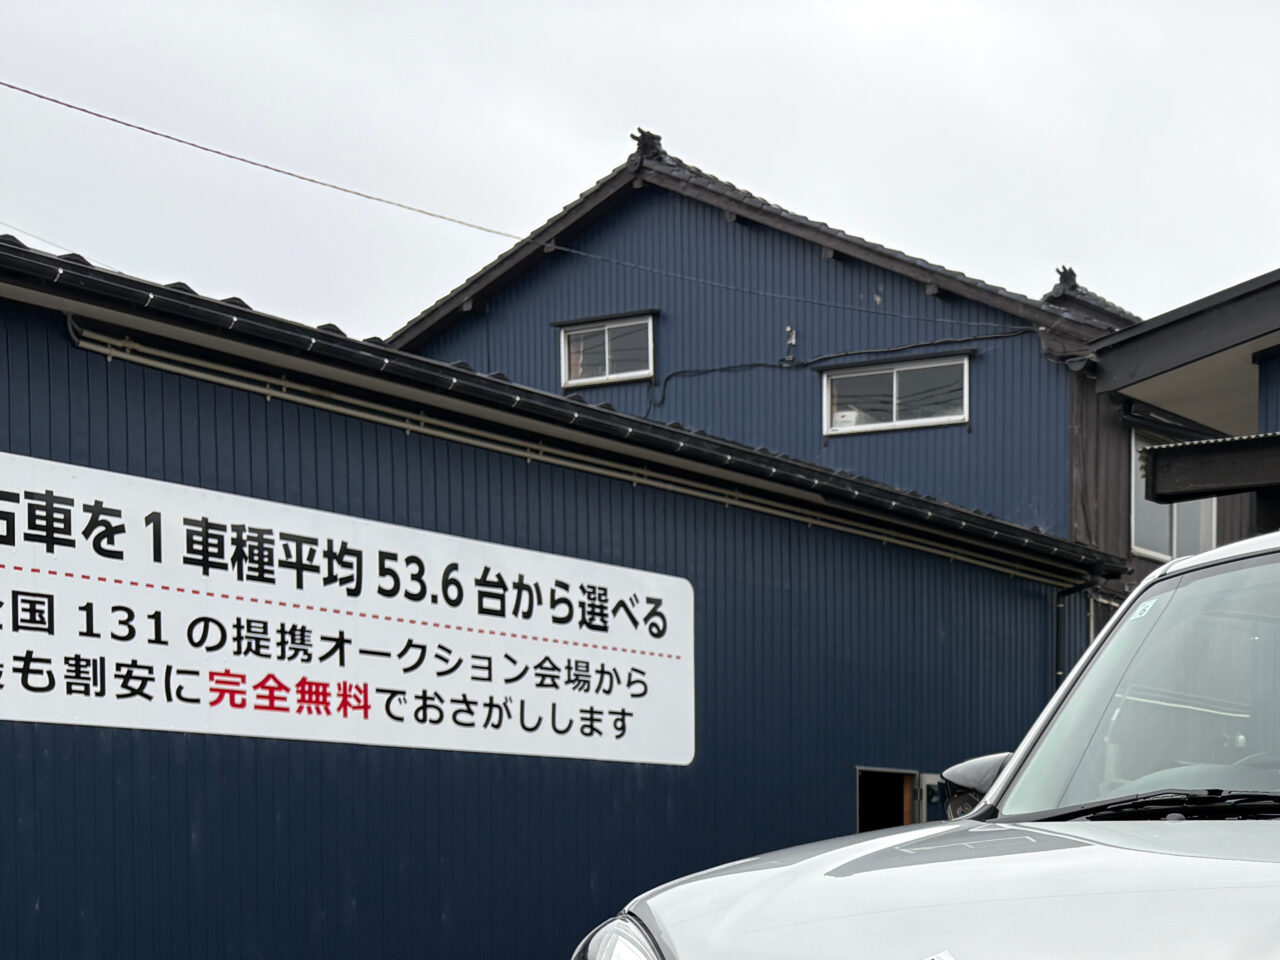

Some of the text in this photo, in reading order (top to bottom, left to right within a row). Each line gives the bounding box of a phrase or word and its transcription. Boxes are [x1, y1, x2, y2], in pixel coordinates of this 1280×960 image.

[0, 589, 649, 699] 国131の提携オークション会場から
[0, 649, 634, 740] も割安に完全無料でおさがしします
